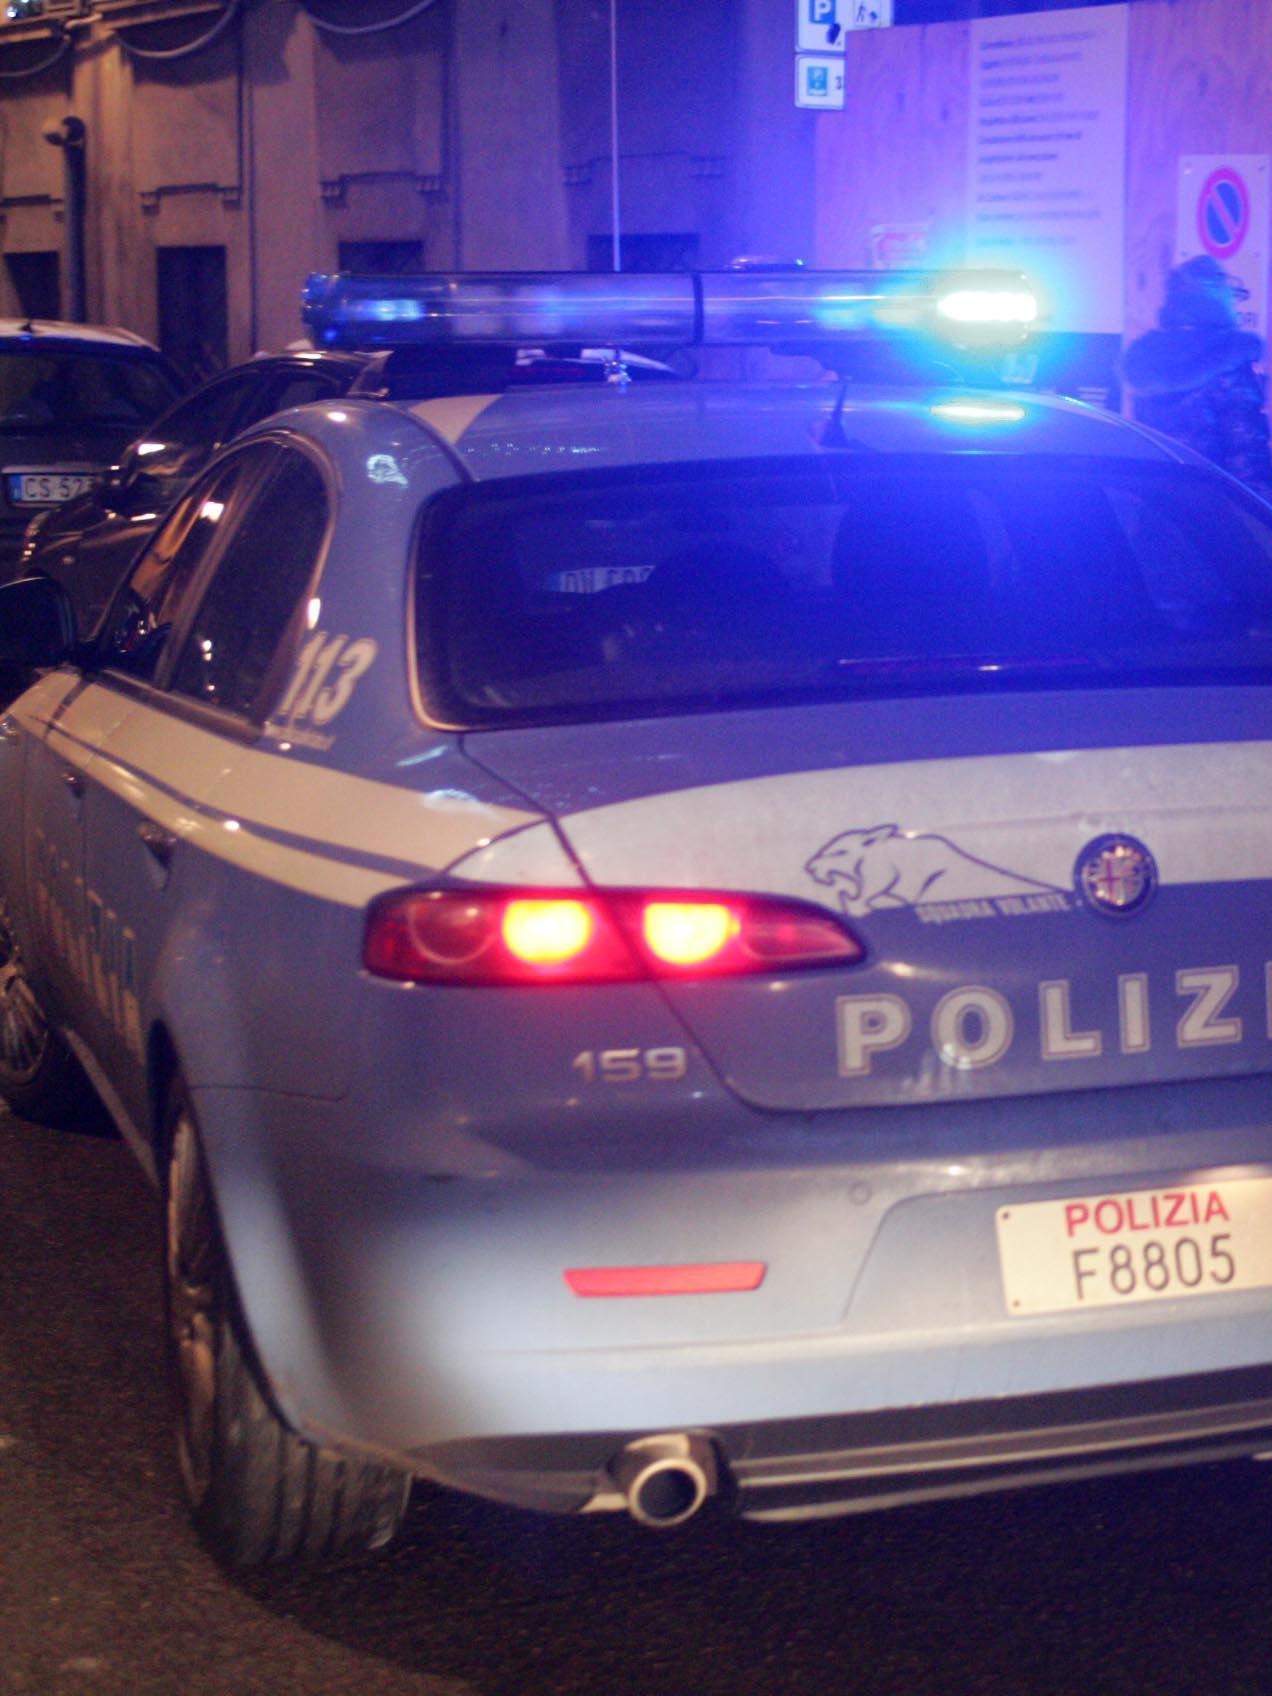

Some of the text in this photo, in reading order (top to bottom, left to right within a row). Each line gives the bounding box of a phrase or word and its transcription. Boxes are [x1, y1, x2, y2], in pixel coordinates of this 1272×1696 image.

[277, 630, 379, 726] 113
[572, 1046, 688, 1084] 159
[1064, 1189, 1231, 1238] POLIZIA
[1072, 1234, 1238, 1301] F8805
